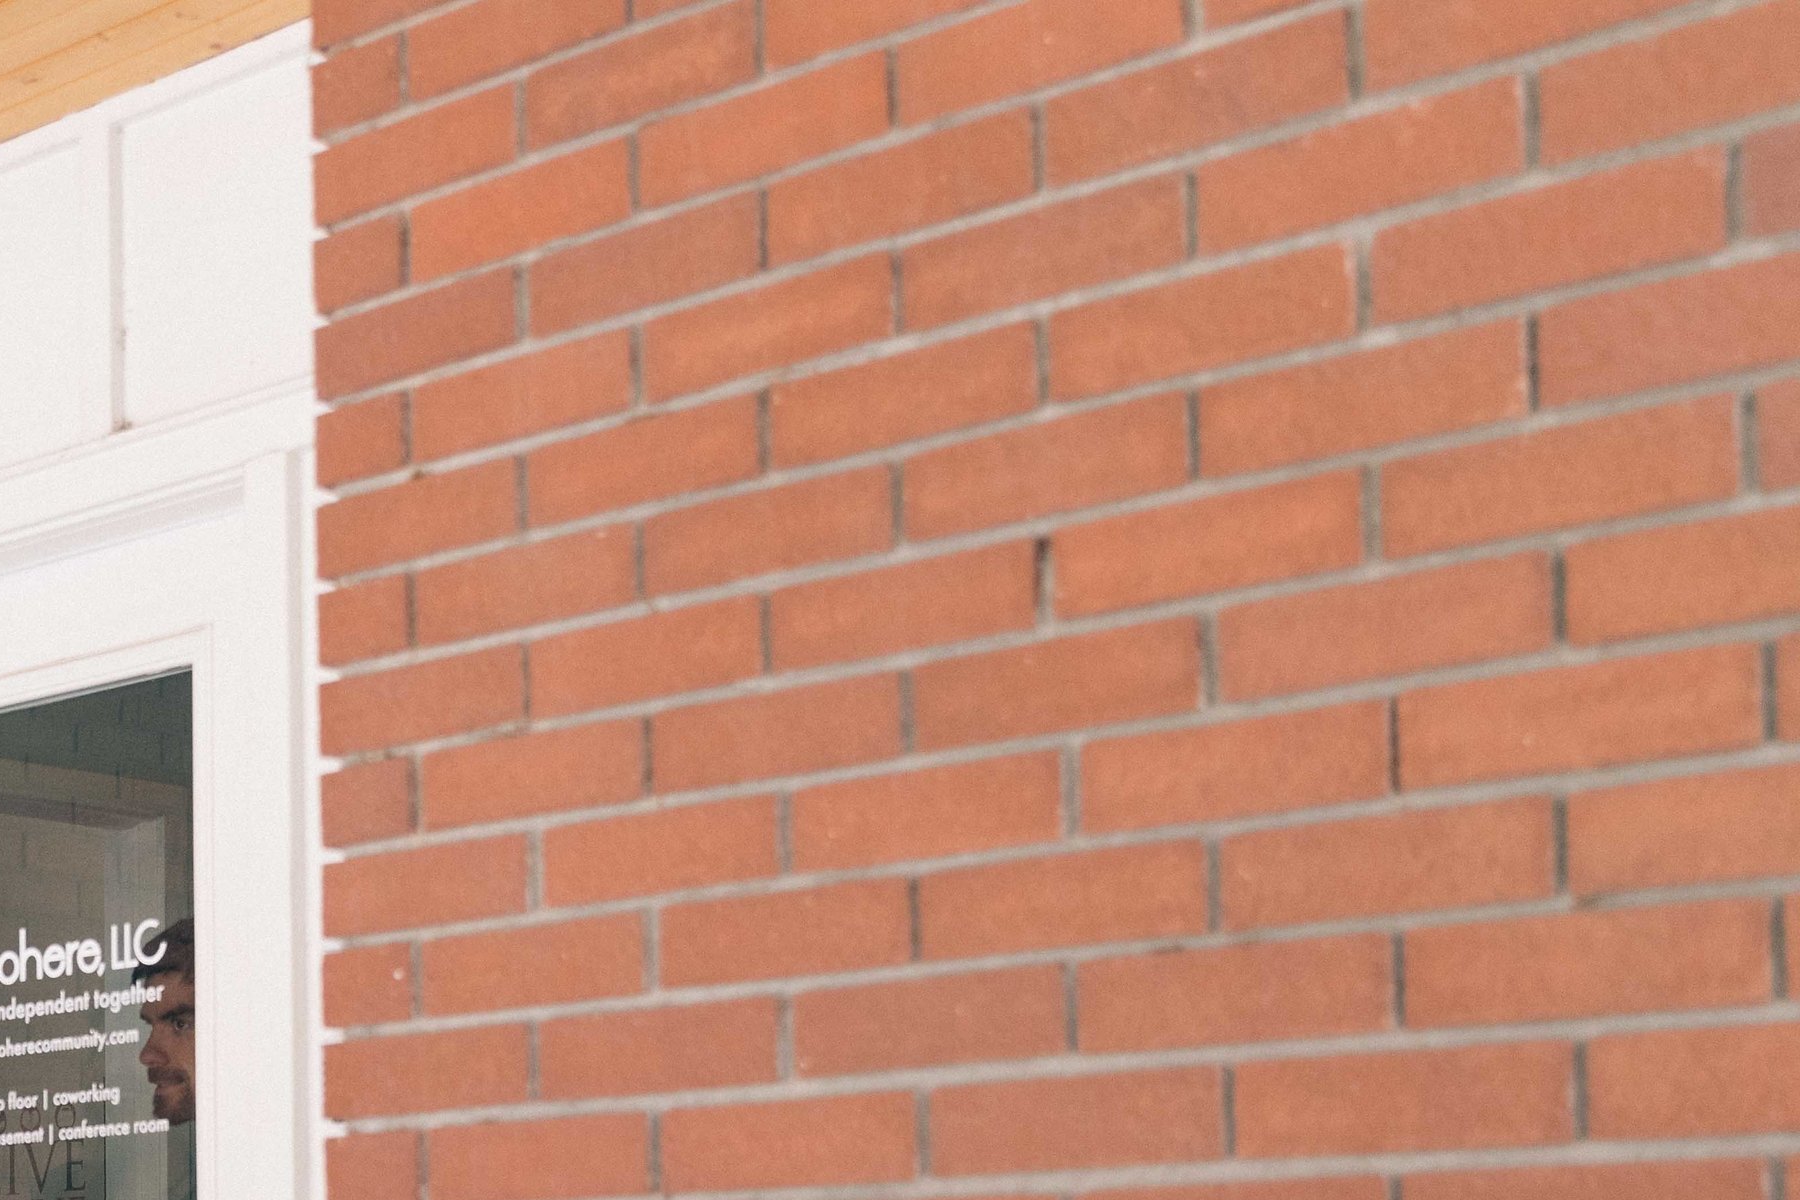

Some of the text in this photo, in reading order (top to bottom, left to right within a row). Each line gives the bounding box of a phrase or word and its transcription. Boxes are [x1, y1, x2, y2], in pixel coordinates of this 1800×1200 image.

[111, 918, 168, 970] LLC
[94, 979, 165, 1013] together
[8, 1091, 39, 1110] floor
[53, 1083, 121, 1105] coworking
[58, 1119, 130, 1141] conference
[133, 1118, 170, 1134] room
